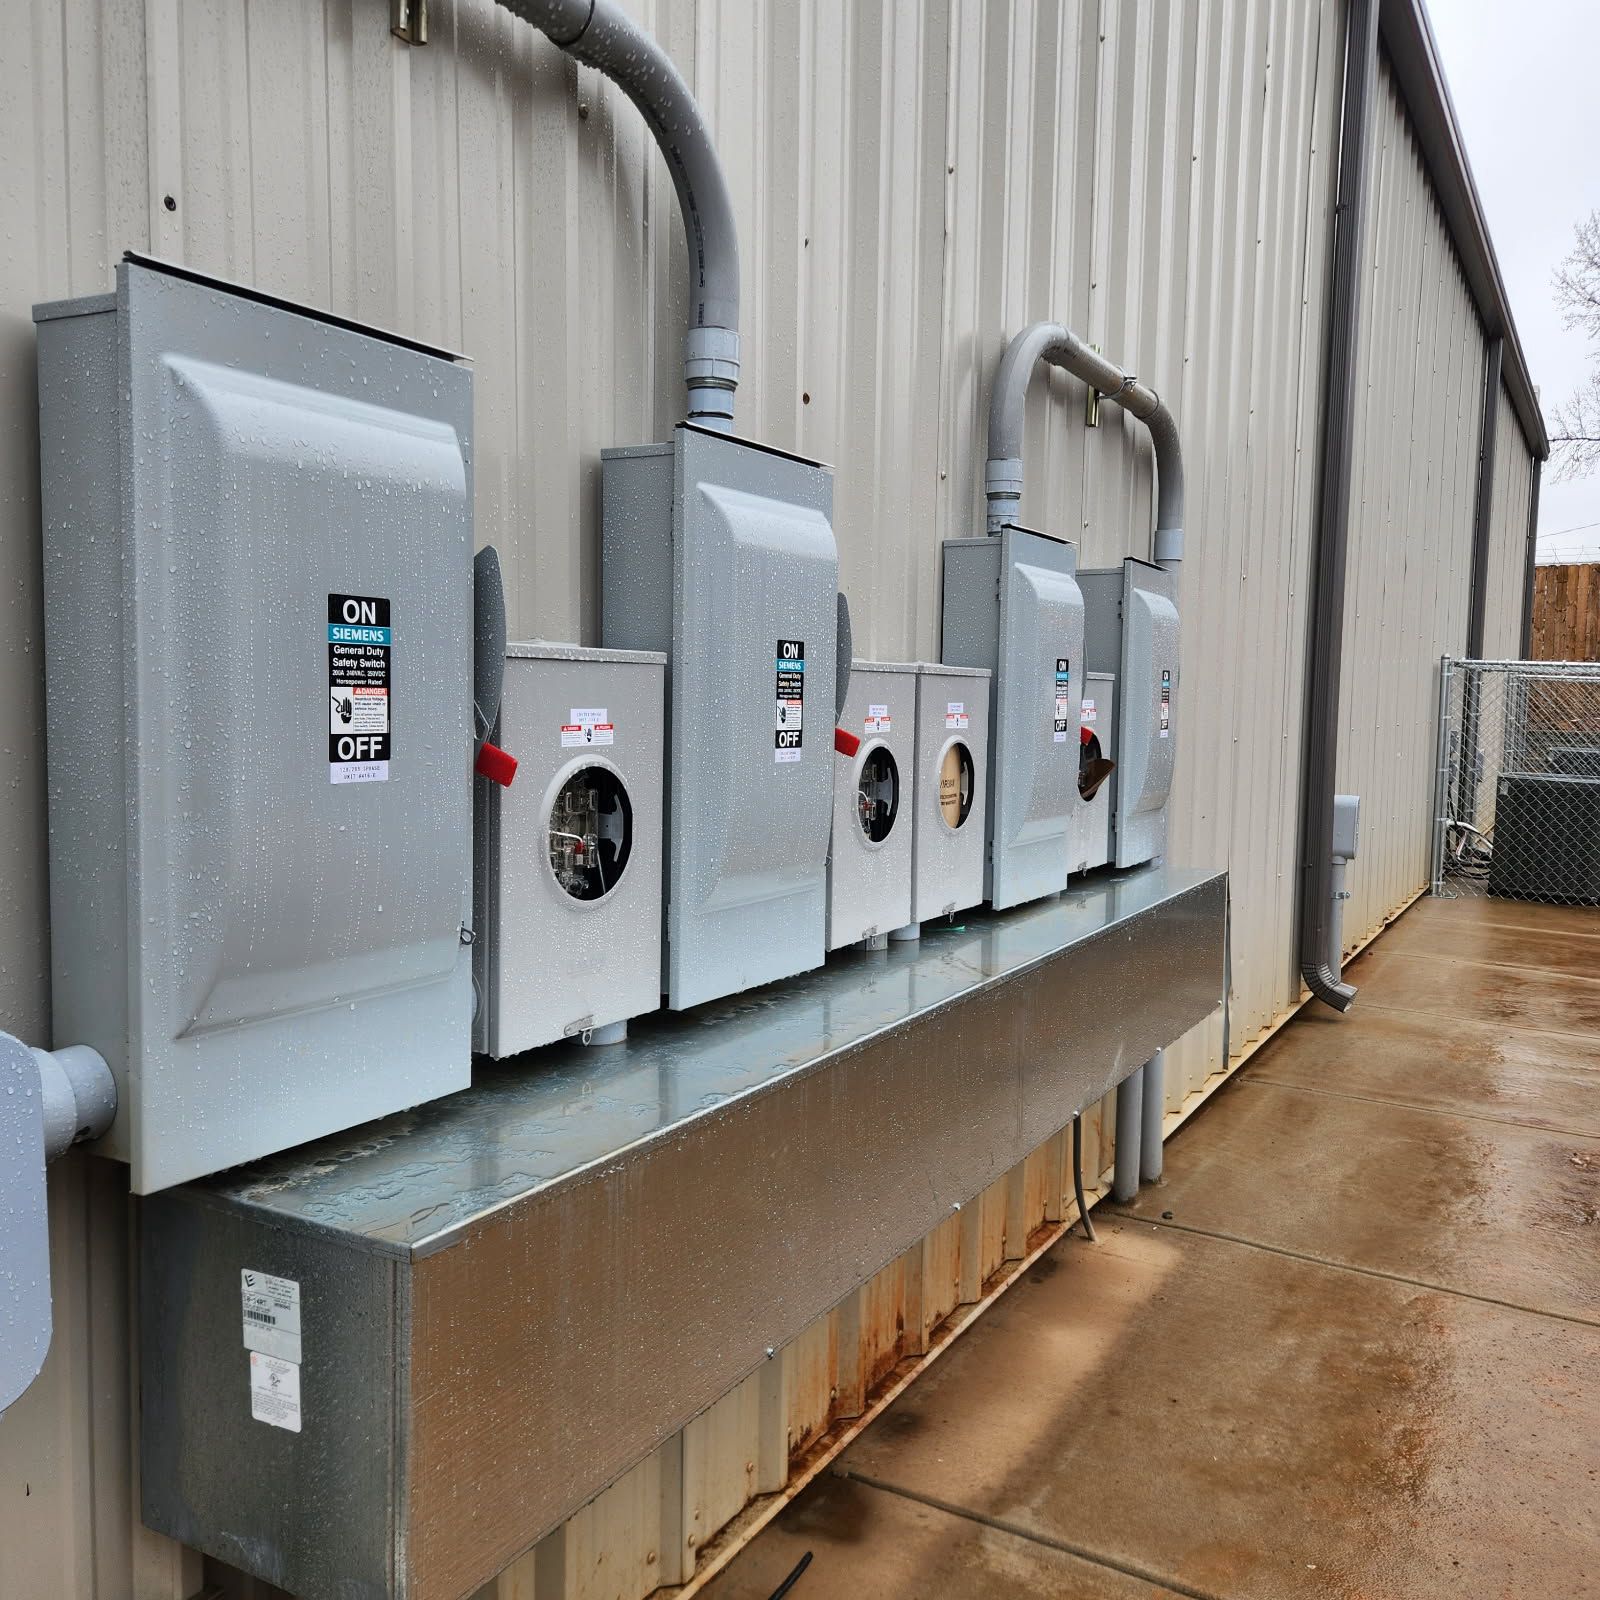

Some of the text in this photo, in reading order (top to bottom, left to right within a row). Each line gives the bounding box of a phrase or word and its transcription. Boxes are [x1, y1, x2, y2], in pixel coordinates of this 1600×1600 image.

[343, 599, 376, 624] ON
[333, 627, 384, 642] SIEMENS
[333, 645, 384, 657] General Duty
[783, 643, 798, 658] ON
[333, 658, 385, 669] Safety Switch
[1058, 660, 1066, 671] ON
[1056, 720, 1066, 731] OFF
[779, 731, 799, 747] OFF
[338, 736, 382, 760] OFF
